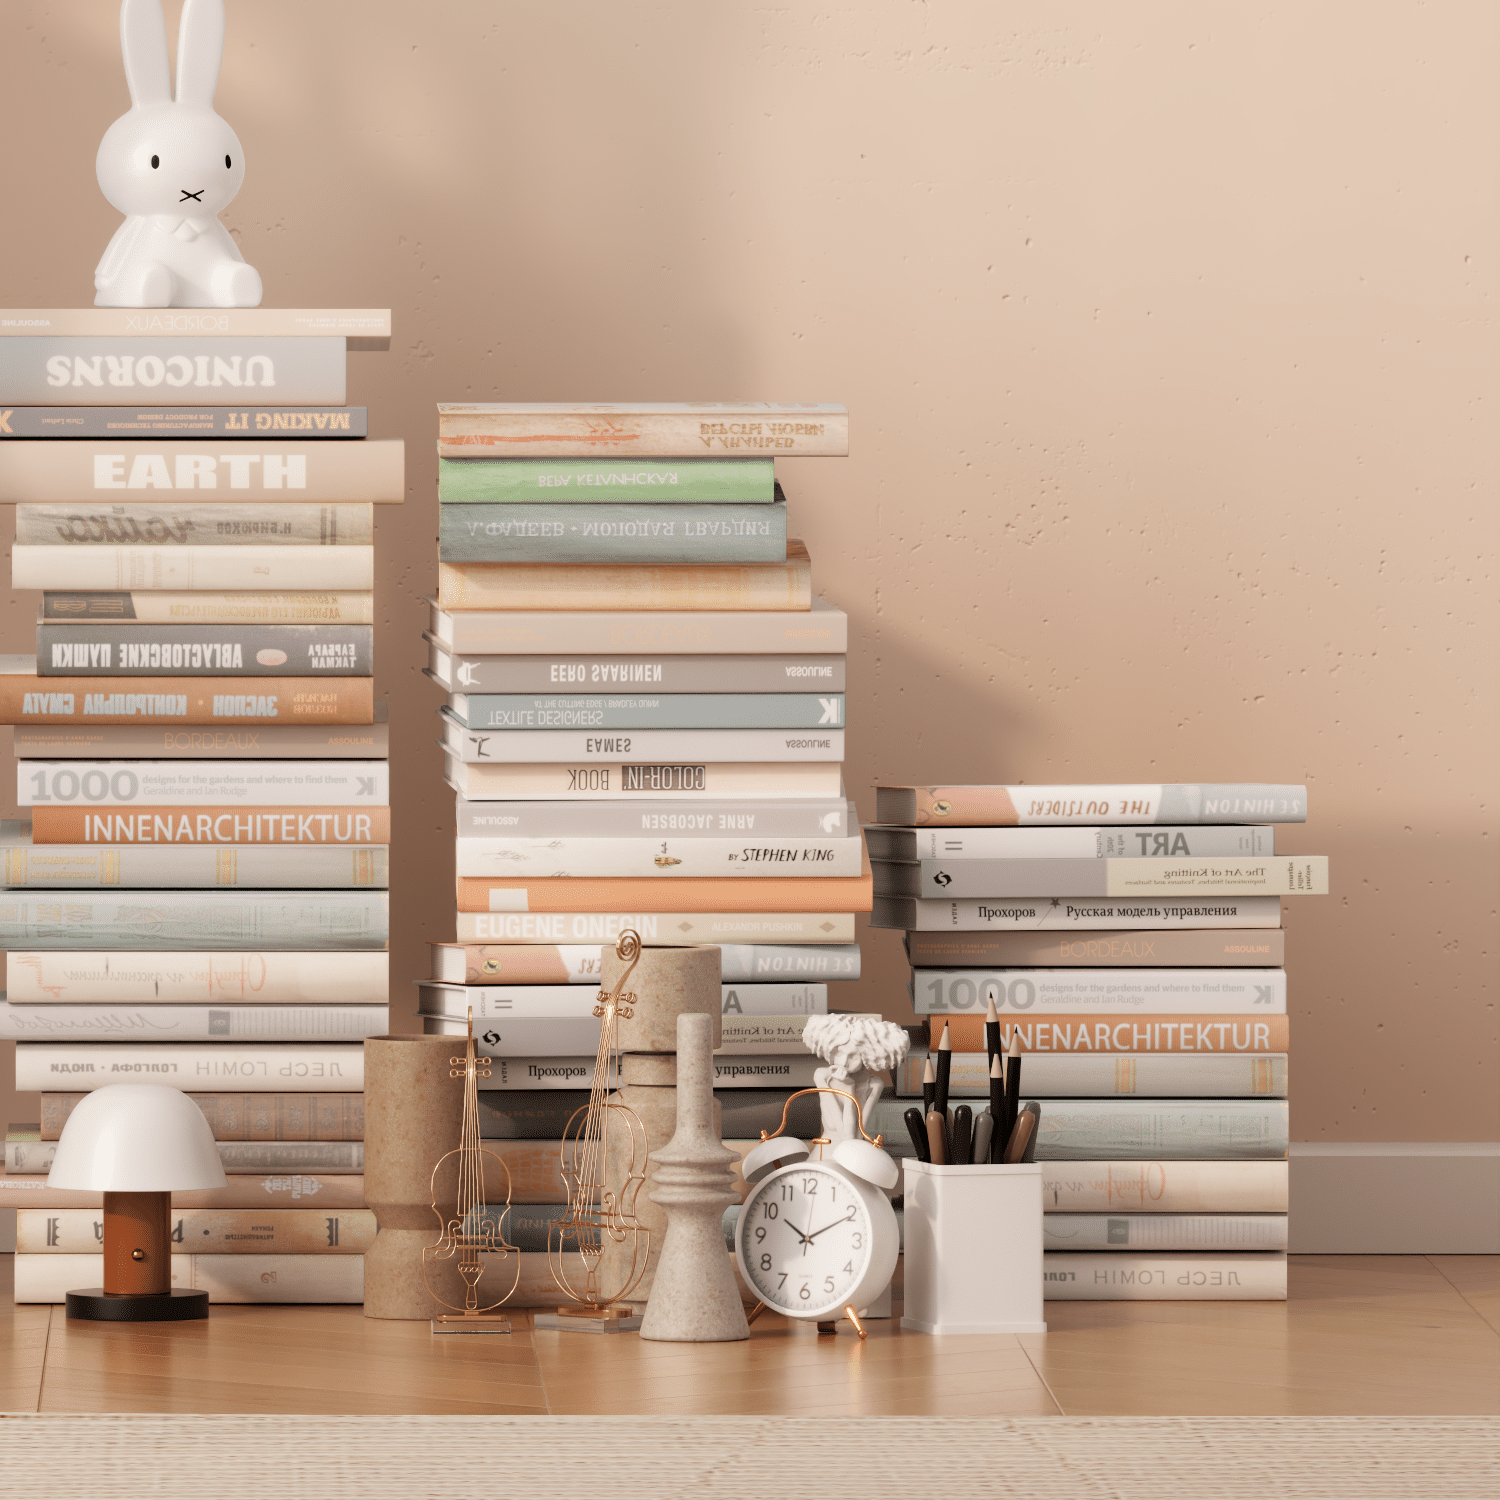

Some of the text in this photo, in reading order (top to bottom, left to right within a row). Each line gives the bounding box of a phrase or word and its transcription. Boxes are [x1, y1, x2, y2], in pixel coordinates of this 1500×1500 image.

[47, 355, 276, 387] UNICORNS
[225, 413, 351, 431] MAKING IT
[94, 454, 306, 489] EARTH
[164, 733, 260, 750] BORDEAUX
[30, 769, 138, 801] 1000
[142, 774, 347, 786] designs for the gardens and where to find them
[568, 769, 610, 790] BOOK
[143, 786, 248, 797] Geraldine and Ian Rudge
[1027, 801, 1151, 815] THE OUTSIDERS
[1205, 798, 1301, 815] SE HINTON
[85, 815, 372, 841] INNENARCHITEKTUR
[472, 816, 519, 825] ASSOULINE
[642, 814, 755, 829] ARNE JACOBSEN
[728, 848, 834, 862] BY STEPHEN KING
[978, 906, 1036, 921] Прохоров
[1066, 906, 1237, 919] Русская модель управления
[475, 915, 657, 939] EUGENE ONEGIN
[712, 922, 802, 931] ALEXANDR PUSHKIN
[1060, 941, 1155, 958] BORDEAUX
[757, 956, 854, 973] SE HINTON
[927, 978, 1035, 1010] 1000
[1040, 983, 1245, 994] designs for the gardens and where to find them
[1040, 994, 1145, 1006] Geraldine and Ian Rudge
[528, 1065, 586, 1080] Прохоров
[716, 1064, 790, 1078] управления
[782, 1185, 793, 1201] 11
[803, 1178, 817, 1194] 12
[831, 1187, 835, 1202] 1
[763, 1202, 778, 1220] 10
[846, 1205, 856, 1221] 2
[756, 1227, 766, 1244] 9
[852, 1232, 862, 1249] 3
[761, 1254, 771, 1271] 8
[843, 1260, 853, 1275] 4
[778, 1273, 788, 1289] 7
[824, 1276, 834, 1293] 5
[800, 1283, 810, 1299] 6
